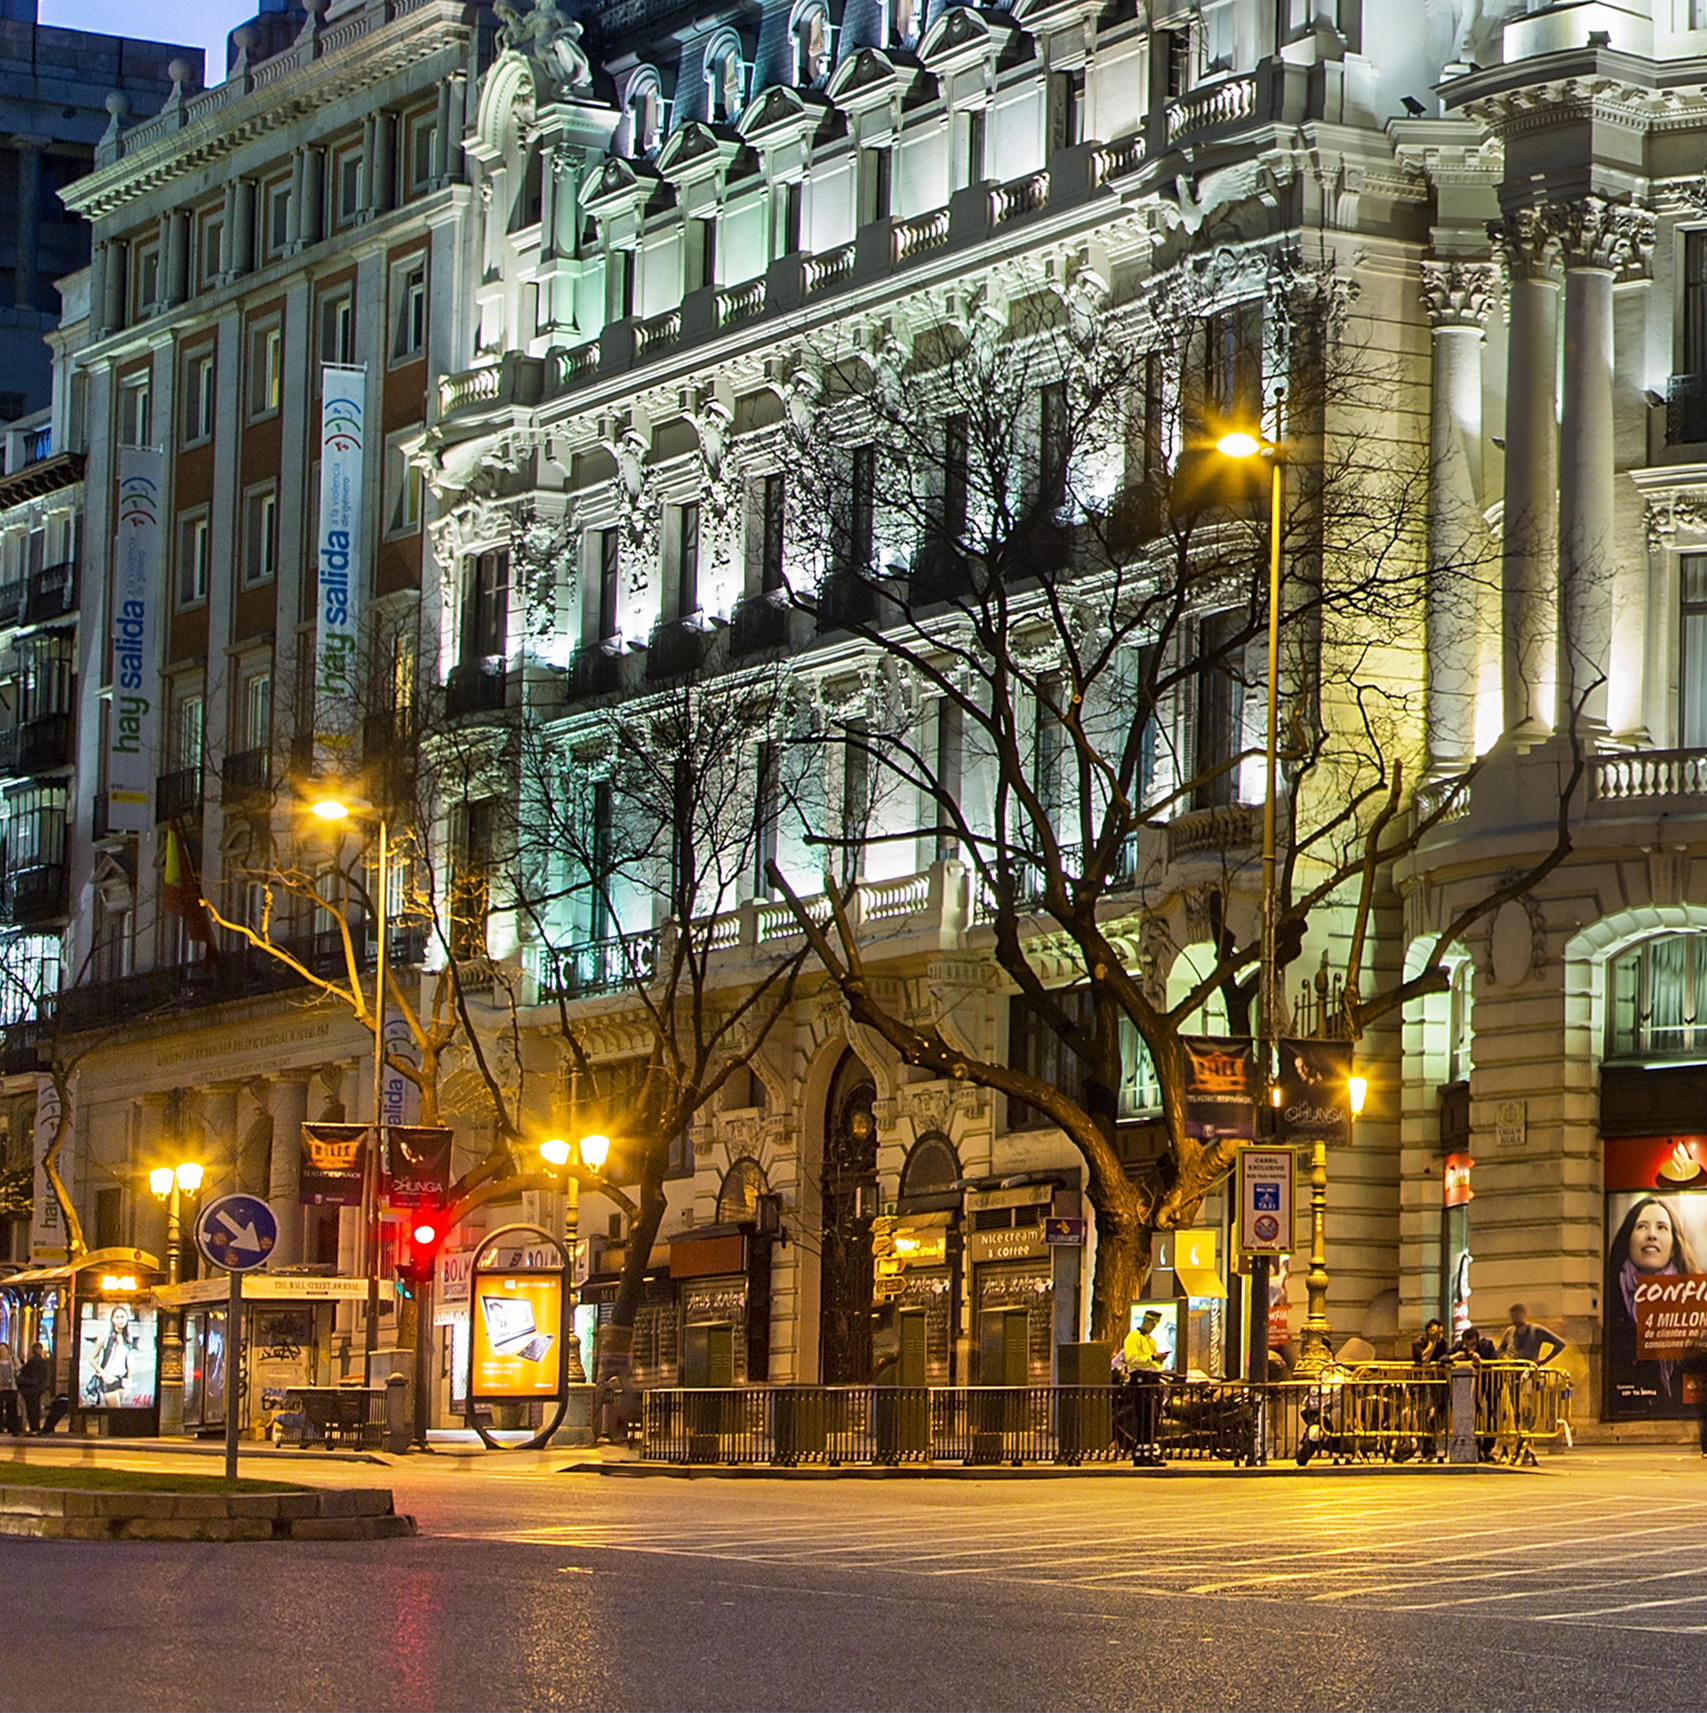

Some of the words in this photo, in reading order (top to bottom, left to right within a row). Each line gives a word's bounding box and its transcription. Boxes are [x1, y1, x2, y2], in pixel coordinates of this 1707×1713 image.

[319, 530, 350, 626] salida
[115, 601, 145, 689] salida
[316, 632, 357, 694] hay
[111, 694, 151, 754] hay
[384, 1078, 404, 1126] alida
[1258, 1202, 1276, 1210] TAXI
[997, 1245, 1031, 1257] coffee
[288, 1282, 304, 1290] WALL
[332, 1283, 360, 1291] JOURNAL
[517, 1280, 550, 1289] Windows
[1645, 1313, 1654, 1328] 4
[1644, 1330, 1655, 1338] de
[1656, 1328, 1686, 1338] clientes
[1688, 1329, 1699, 1338] no
